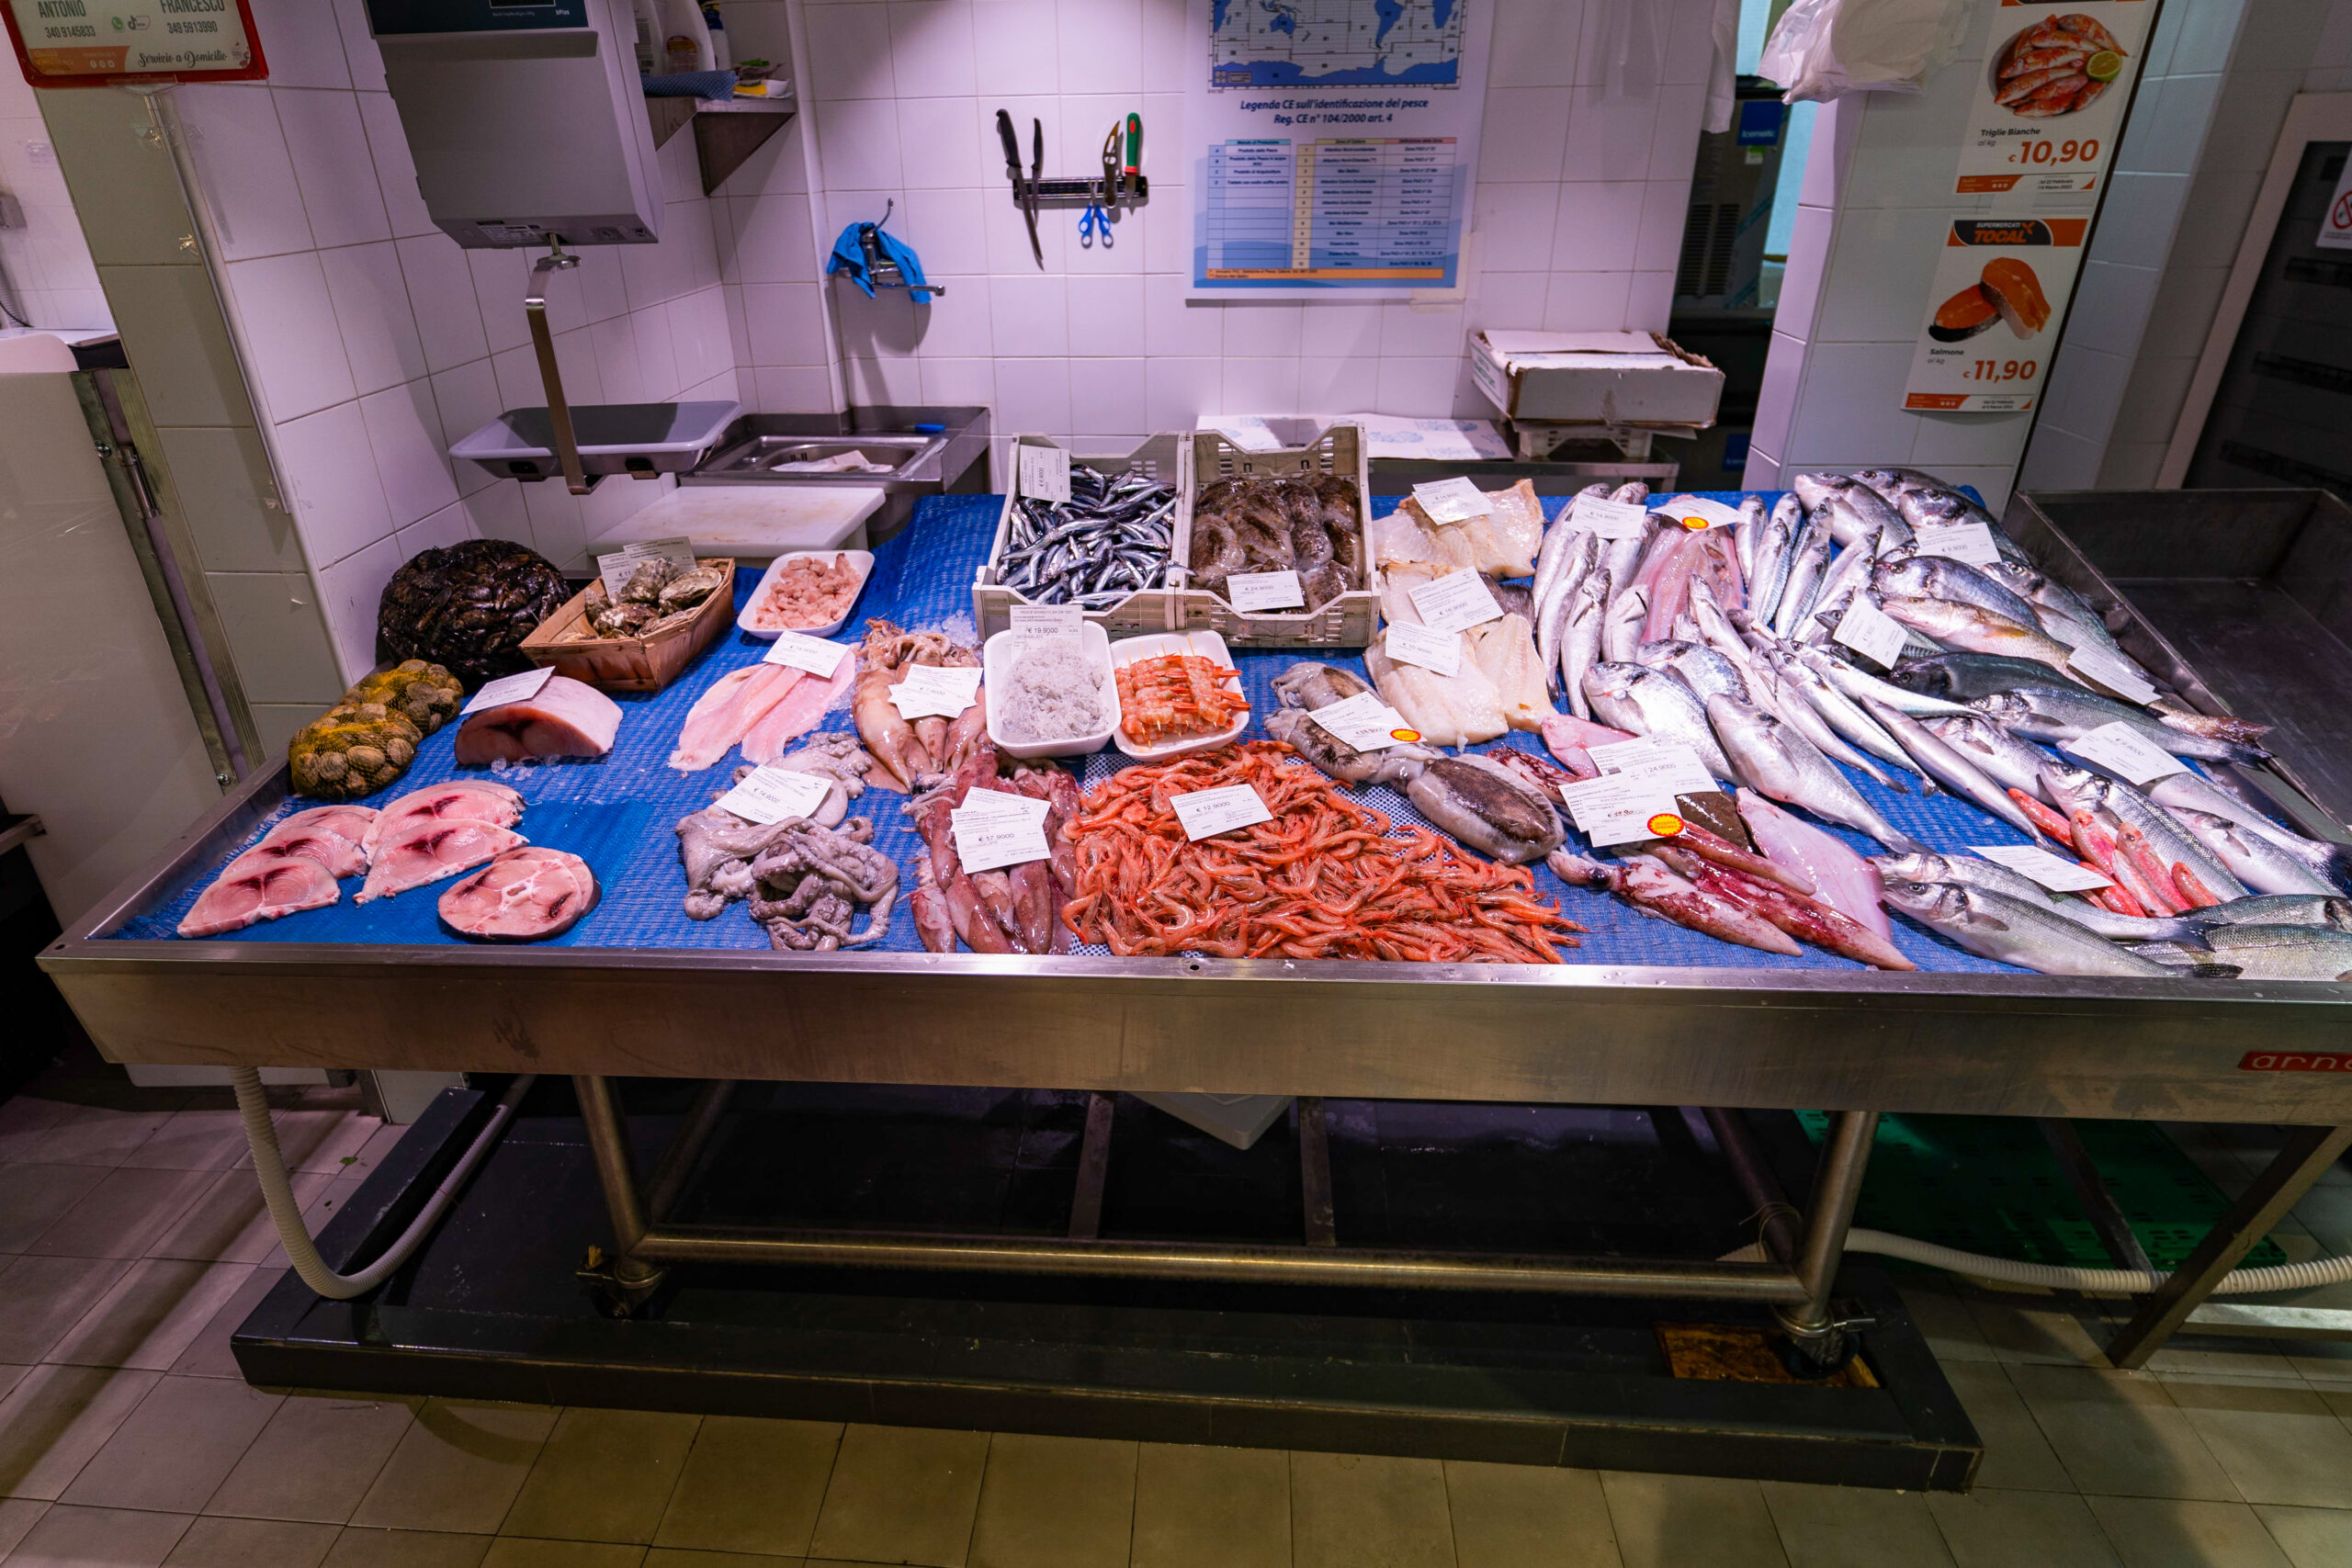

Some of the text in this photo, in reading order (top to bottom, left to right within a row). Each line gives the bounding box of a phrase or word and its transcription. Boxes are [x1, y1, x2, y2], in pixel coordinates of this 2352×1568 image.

[39, 0, 86, 17] ANTONIO
[162, 0, 225, 14] FRANCESCO
[45, 27, 61, 39] 340
[167, 20, 218, 34] 349 5913990
[138, 52, 174, 68] Servizio
[187, 51, 227, 68] Domicilio
[1240, 98, 1429, 110] Legenda CE sull'identificazione del pesce
[1274, 114, 1295, 125] Reg.
[1296, 114, 1308, 123] CE
[1322, 113, 1366, 123] 104/2000
[1367, 115, 1384, 123] art.
[1386, 114, 1393, 122] 4
[1982, 129, 2006, 137] Triglie
[2008, 140, 2099, 166] € 10,90
[1974, 360, 2037, 383] 11,90
